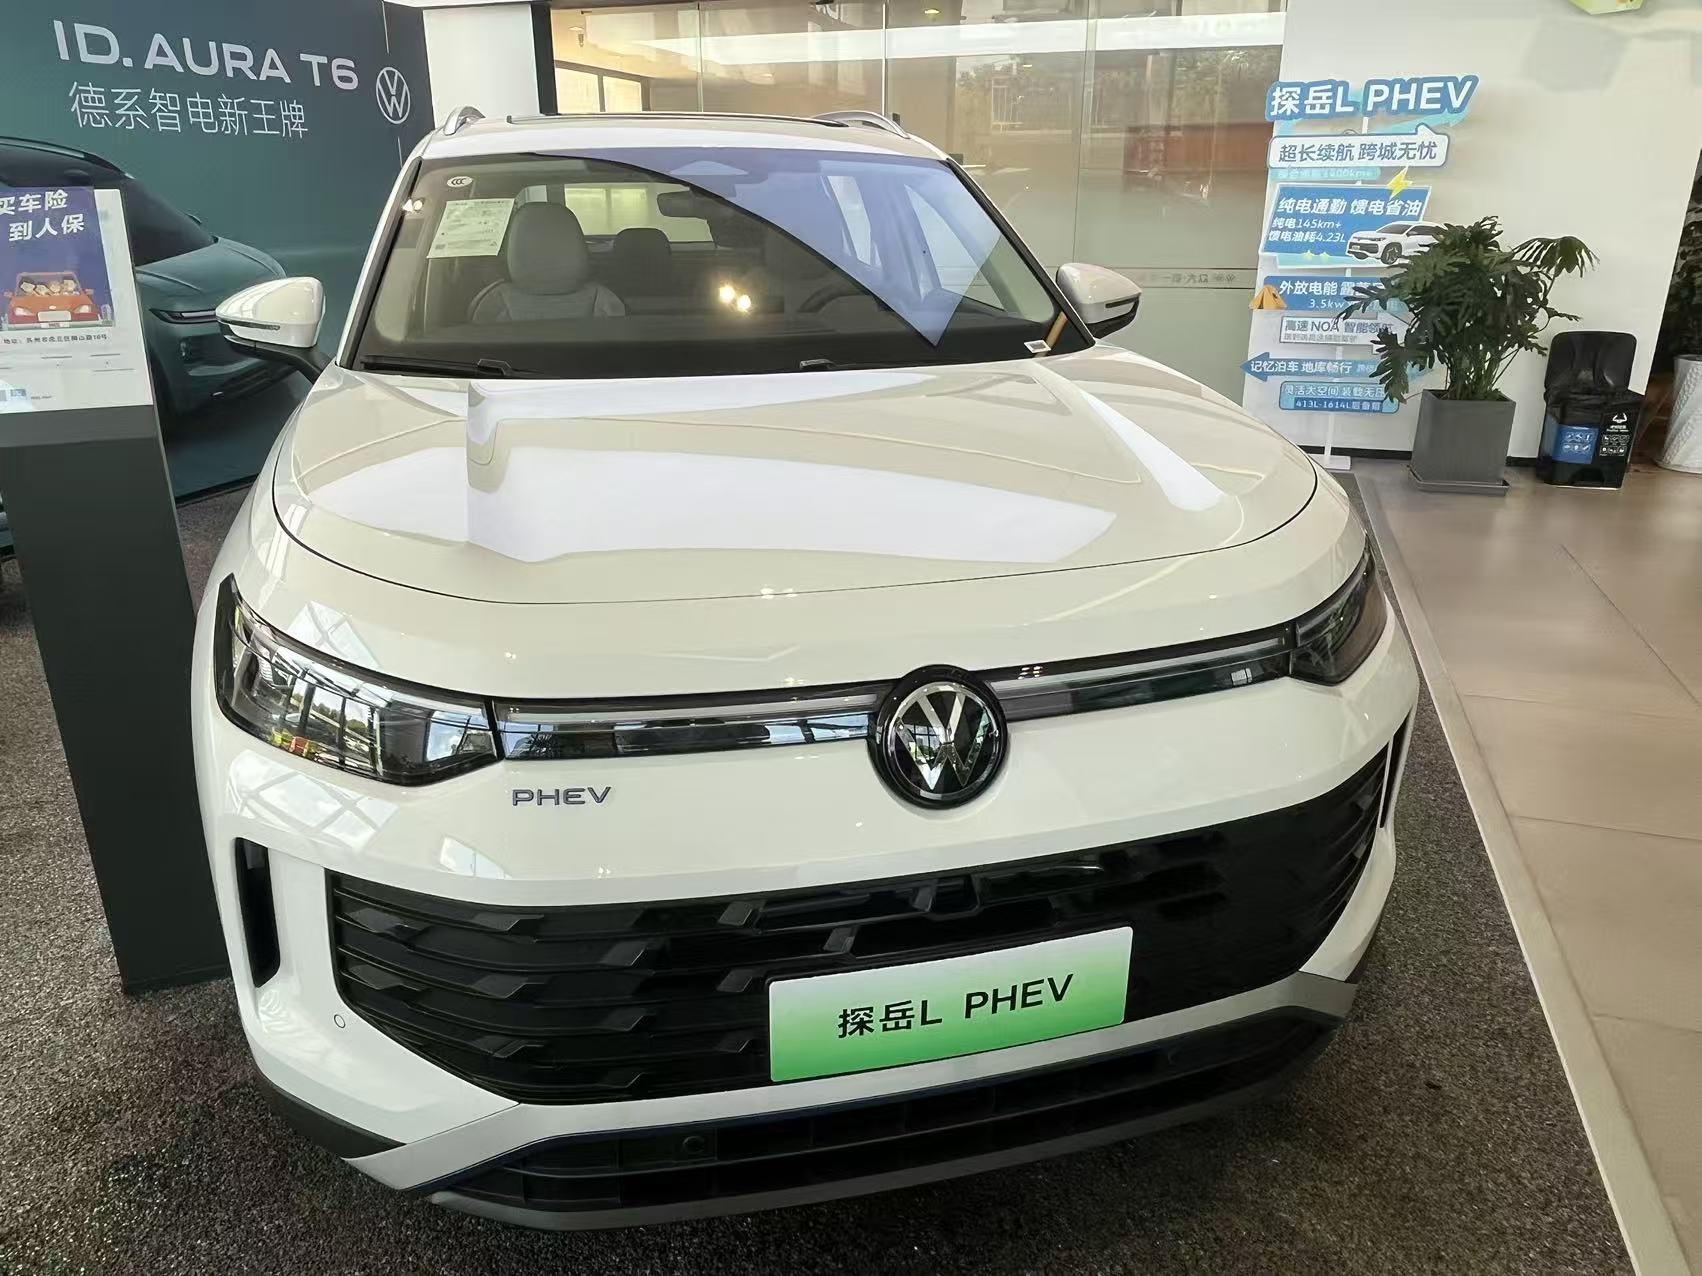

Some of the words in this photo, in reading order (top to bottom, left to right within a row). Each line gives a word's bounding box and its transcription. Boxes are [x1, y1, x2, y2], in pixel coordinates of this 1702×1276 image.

[53, 19, 133, 67] ID.
[144, 33, 291, 83] AURA
[300, 53, 359, 90] T6
[1270, 84, 1354, 116] 探岳L
[1366, 80, 1473, 112] PHEV
[69, 81, 308, 138] 德系智电新王牌
[1278, 144, 1355, 162] 超长续航
[1357, 140, 1438, 161] 跨城无忧
[0, 189, 68, 216] 买车险
[1277, 197, 1347, 214] 纯电通勤
[1350, 199, 1423, 217] 馈电省油
[8, 213, 85, 242] 到人保
[1272, 217, 1342, 229] 纯电145km+
[1268, 231, 1348, 243] 馈电油耗4.23L
[1279, 280, 1338, 296] 外放电能
[1285, 320, 1309, 333] 高速
[1311, 321, 1340, 333] NOA
[1251, 360, 1299, 373] 记忆泊车
[1302, 361, 1352, 374] 地库畅行
[512, 786, 611, 806] PHEV
[838, 1000, 942, 1038] 探岳L
[964, 973, 1074, 1019] PHEV
